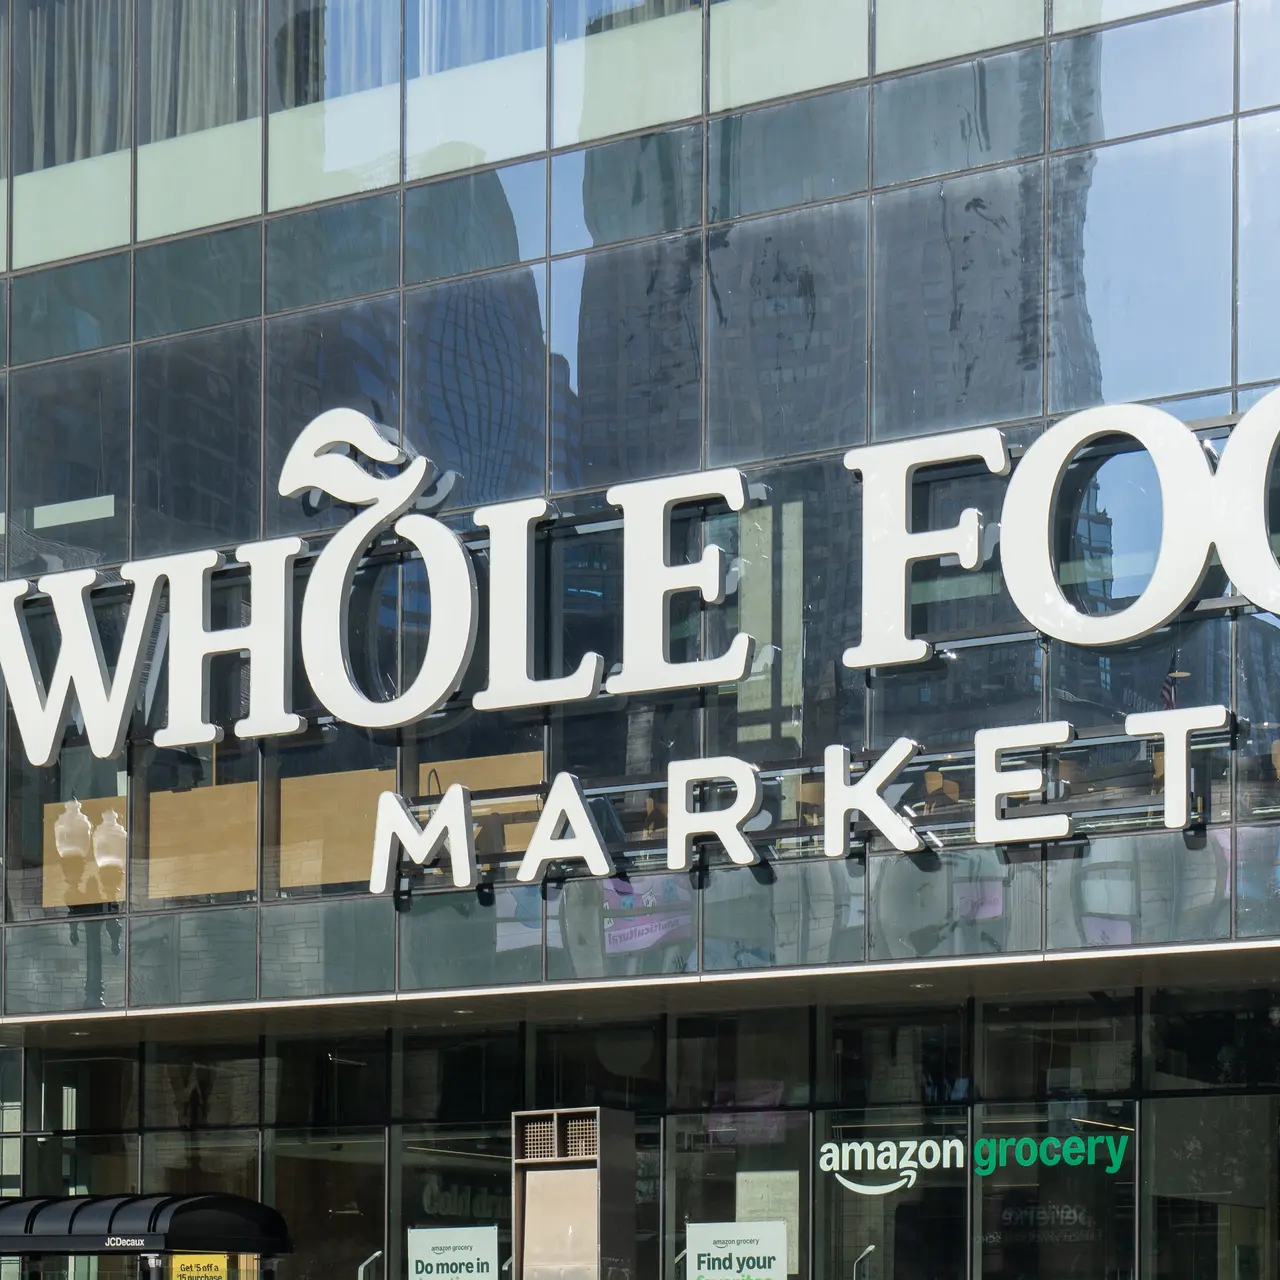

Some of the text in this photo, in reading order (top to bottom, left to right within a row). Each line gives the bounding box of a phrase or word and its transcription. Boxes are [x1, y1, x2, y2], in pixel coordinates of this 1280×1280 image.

[370, 704, 1230, 894] MARKET
[819, 1134, 1129, 1177] amazon grocery
[104, 1237, 145, 1247] JCDecaux
[736, 1238, 760, 1246] grocery
[180, 1263, 193, 1272] Get
[202, 1263, 213, 1272] off
[415, 1257, 490, 1274] Do more in
[697, 1252, 776, 1273] Find your
